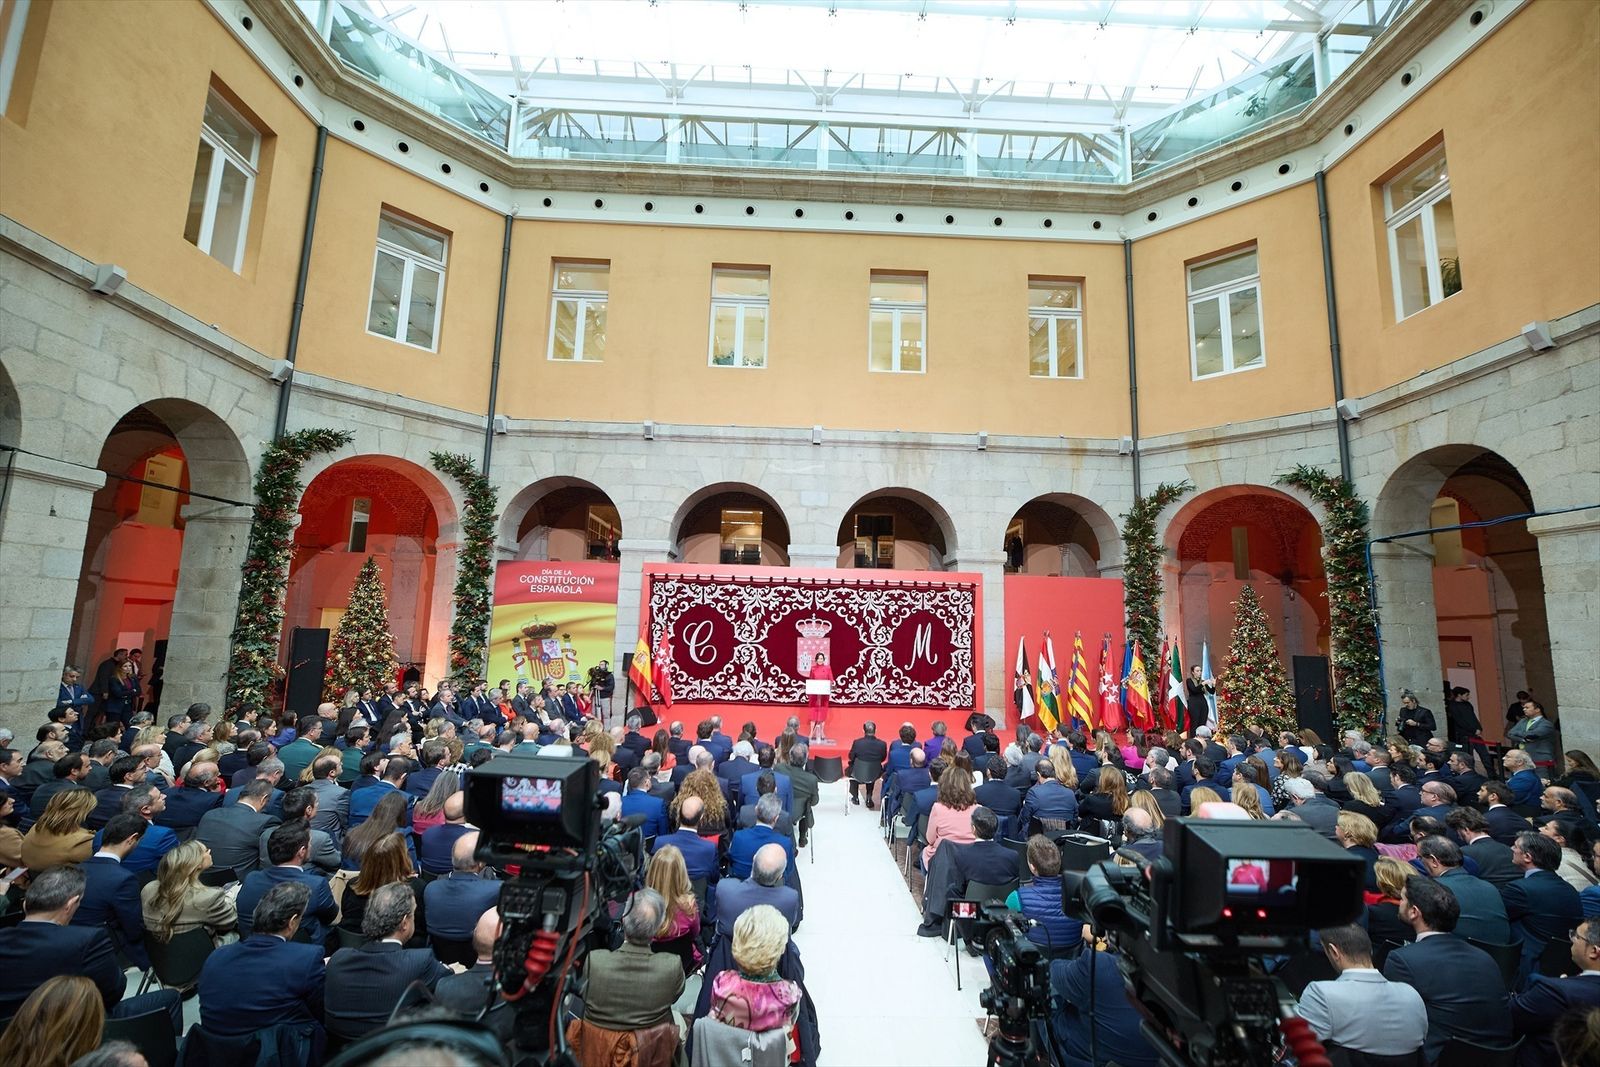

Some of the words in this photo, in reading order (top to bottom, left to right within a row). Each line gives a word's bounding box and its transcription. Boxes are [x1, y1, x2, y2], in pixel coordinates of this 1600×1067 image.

[519, 574, 595, 585] CONSTITUCIÓN
[530, 584, 583, 594] ESPAÑOLA
[682, 620, 717, 665] C
[904, 623, 938, 671] M
